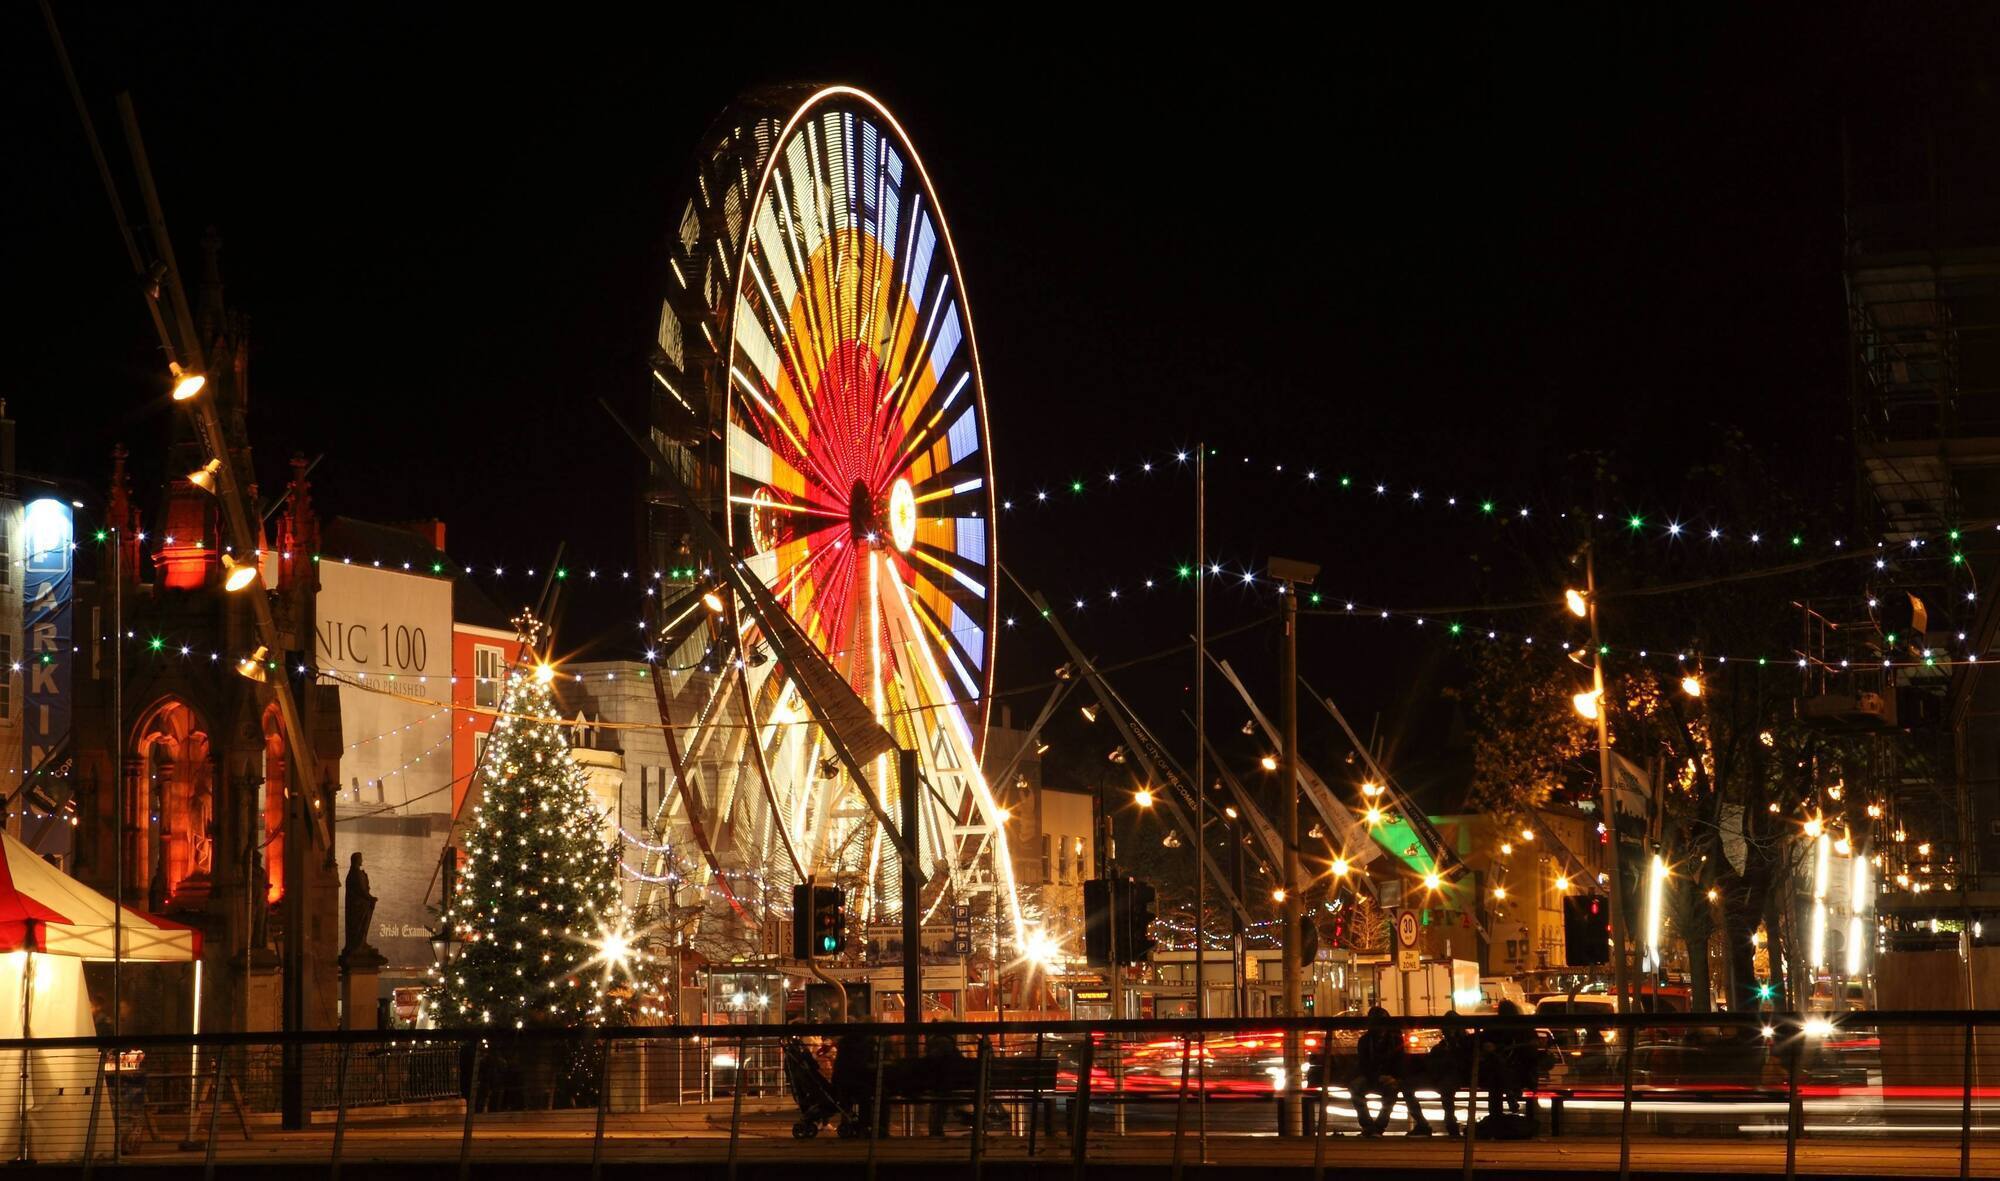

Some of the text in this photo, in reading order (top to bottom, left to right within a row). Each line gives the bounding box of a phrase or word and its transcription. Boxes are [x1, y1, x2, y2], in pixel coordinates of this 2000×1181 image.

[380, 622, 427, 672] 100
[383, 679, 426, 698] PERISHED
[1130, 721, 1149, 743] CORK
[1145, 742, 1160, 759] CITY
[379, 923, 436, 938] Irish Examine
[766, 923, 774, 953] TAXI
[784, 923, 792, 953] TAXI
[1403, 918, 1413, 934] 30
[1402, 961, 1417, 969] ZONE
